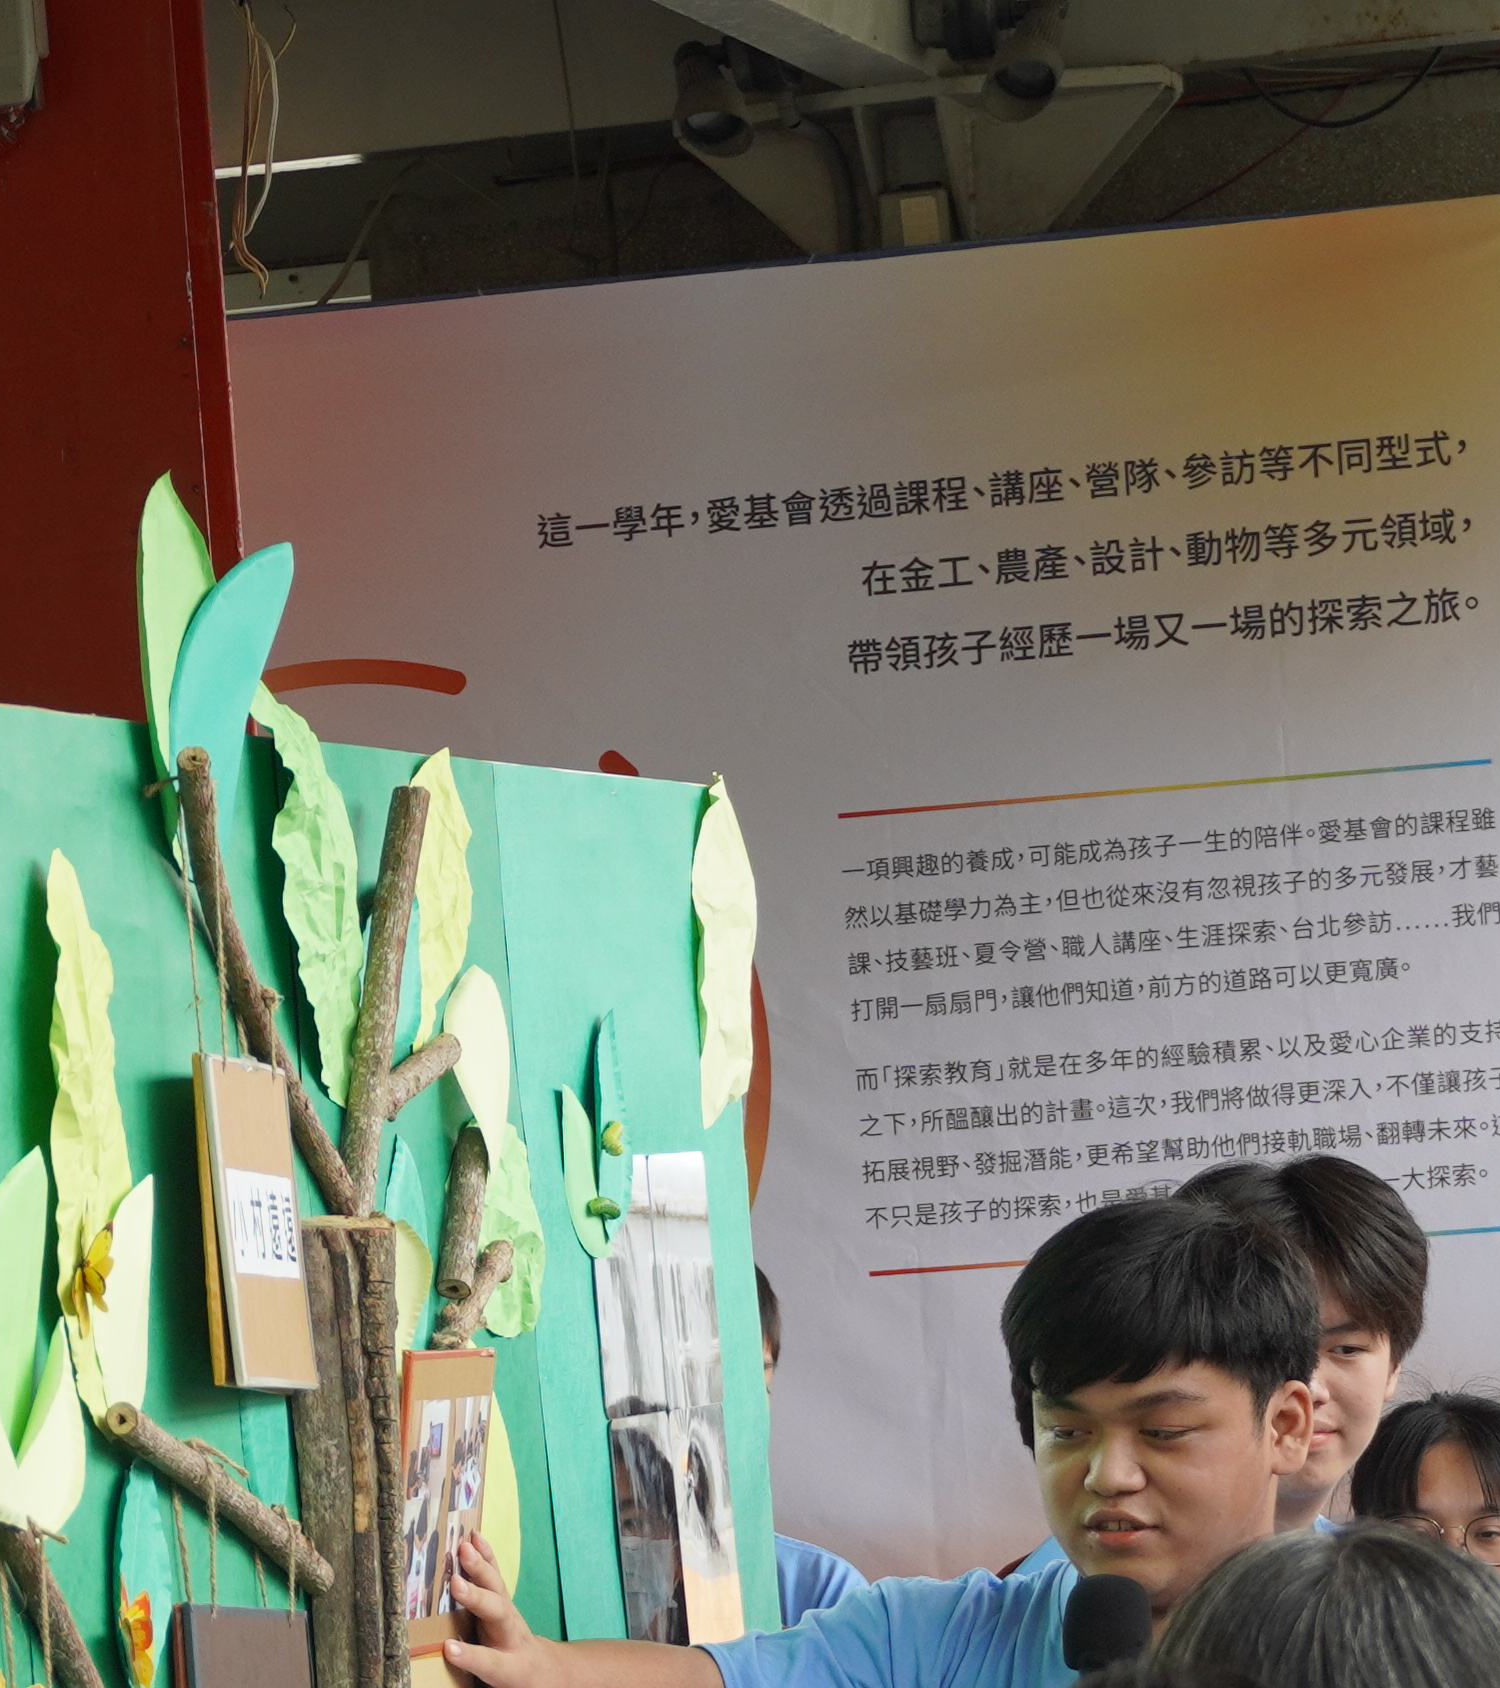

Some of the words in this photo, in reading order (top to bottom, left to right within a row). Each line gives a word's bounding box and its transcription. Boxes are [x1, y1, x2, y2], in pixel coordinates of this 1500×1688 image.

[536, 430, 1468, 550] 這一學年，愛基會透過課程、講座、營隊、參訪等不同型式，
[861, 507, 1473, 598] 在金工、農產、設計、動物等多元領域，
[847, 586, 1479, 676] 帶領孩子經歷一場又一場的探索之旅。
[841, 806, 1497, 883] 一項興趣的養成，可能成為孩子一生的陪伴。愛基會的課程雖
[844, 853, 1500, 930] 然以基礎學力為主，但也從來沒有忽視孩子的多元發展，才藝
[850, 956, 1411, 1023] 打開一扇扇門，讓他們知道，前方的道路可以更寬廣。
[232, 1185, 298, 1263] 小村遠遠
